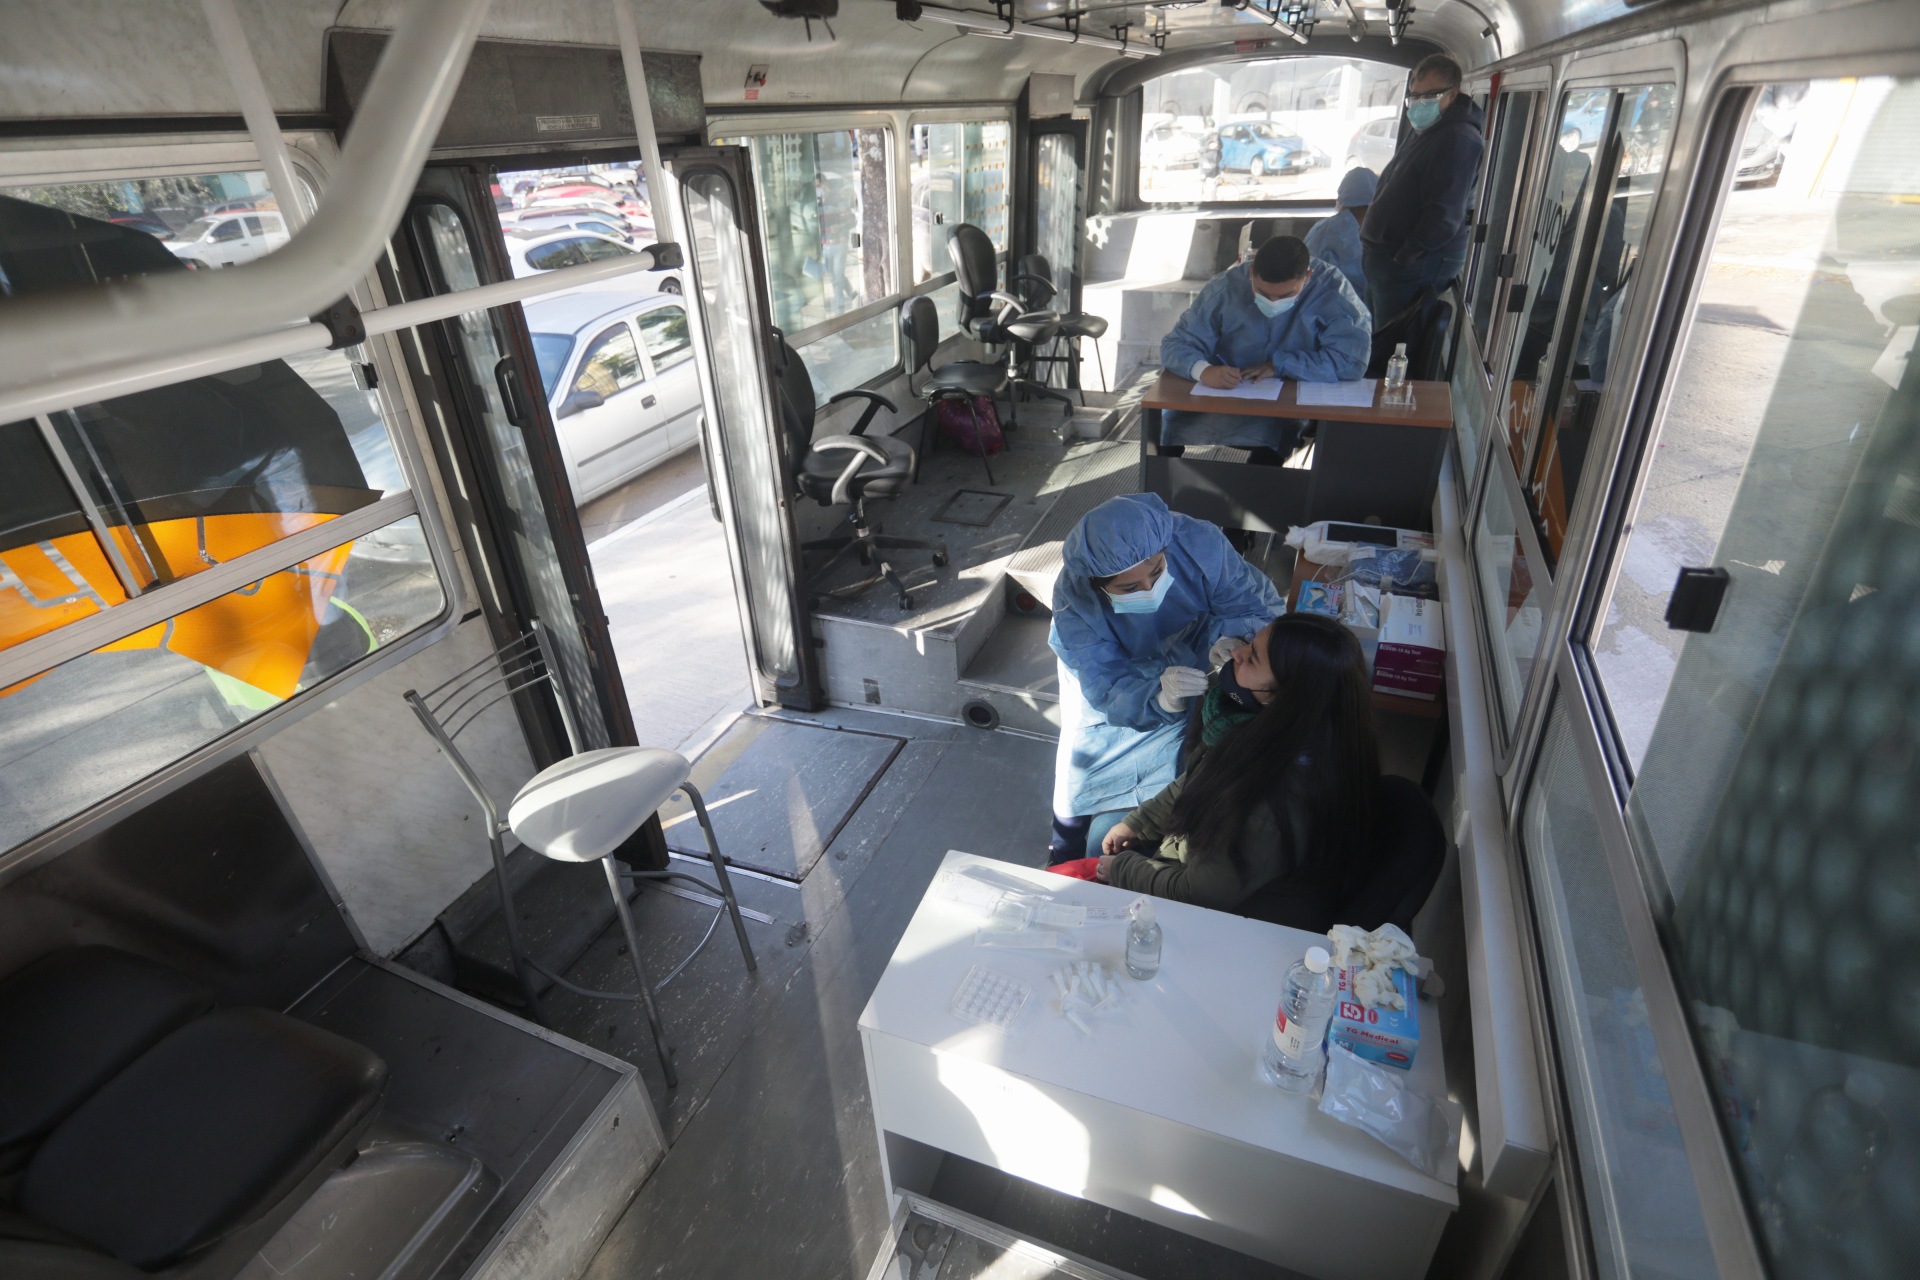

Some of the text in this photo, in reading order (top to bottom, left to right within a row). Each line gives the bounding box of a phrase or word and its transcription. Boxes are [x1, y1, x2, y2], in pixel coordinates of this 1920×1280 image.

[1346, 1026, 1358, 1035] TG
[1360, 1030, 1399, 1045] Medical
[1338, 1040, 1350, 1048] M
